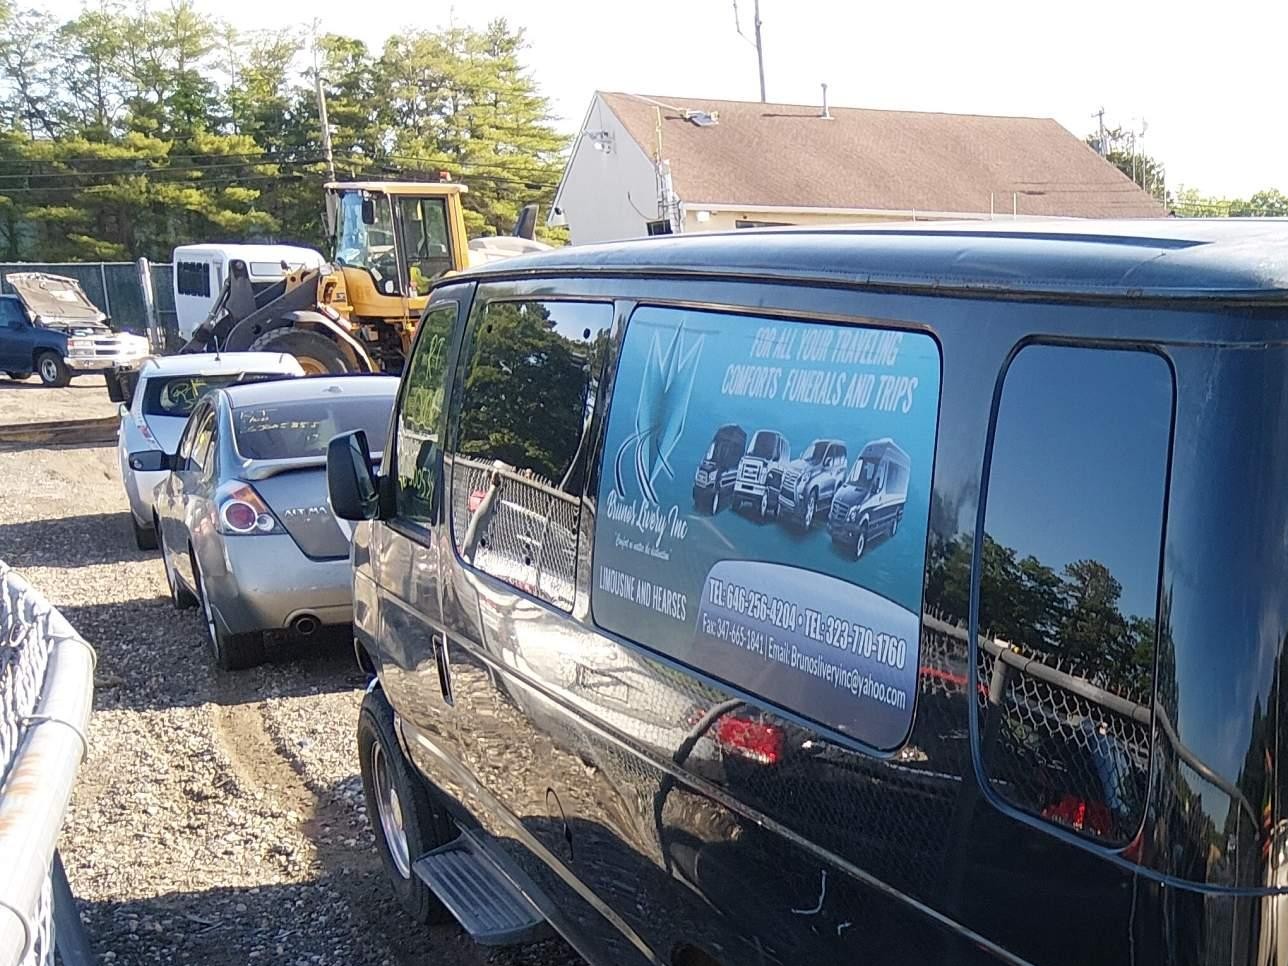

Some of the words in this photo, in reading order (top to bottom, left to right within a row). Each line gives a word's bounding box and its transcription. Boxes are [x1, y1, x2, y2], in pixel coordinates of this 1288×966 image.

[750, 327, 777, 358] FOR
[770, 329, 798, 360] ALL
[796, 329, 834, 362] YOUR
[831, 330, 904, 367] TRAVELING
[721, 363, 782, 400] COMFORTS
[782, 368, 847, 407] FUNERALS
[842, 373, 876, 409] AND
[873, 374, 919, 415] TRIPS
[606, 492, 638, 527] Brunos
[635, 497, 667, 548] Livery
[668, 505, 689, 540] Inc
[600, 565, 636, 601] LIMOUSINE
[636, 579, 651, 607] AND
[652, 585, 687, 621] HEARSES
[708, 577, 726, 606] TEL:
[726, 583, 798, 632] 646-256-4204
[805, 608, 826, 641] TEL:
[826, 616, 907, 670] 323-770-1760
[702, 612, 717, 635] Fax:
[717, 618, 764, 656] 347-665-1841
[768, 636, 791, 665] Email:
[790, 645, 906, 711] Brunosliveryinc@yahoo.com
